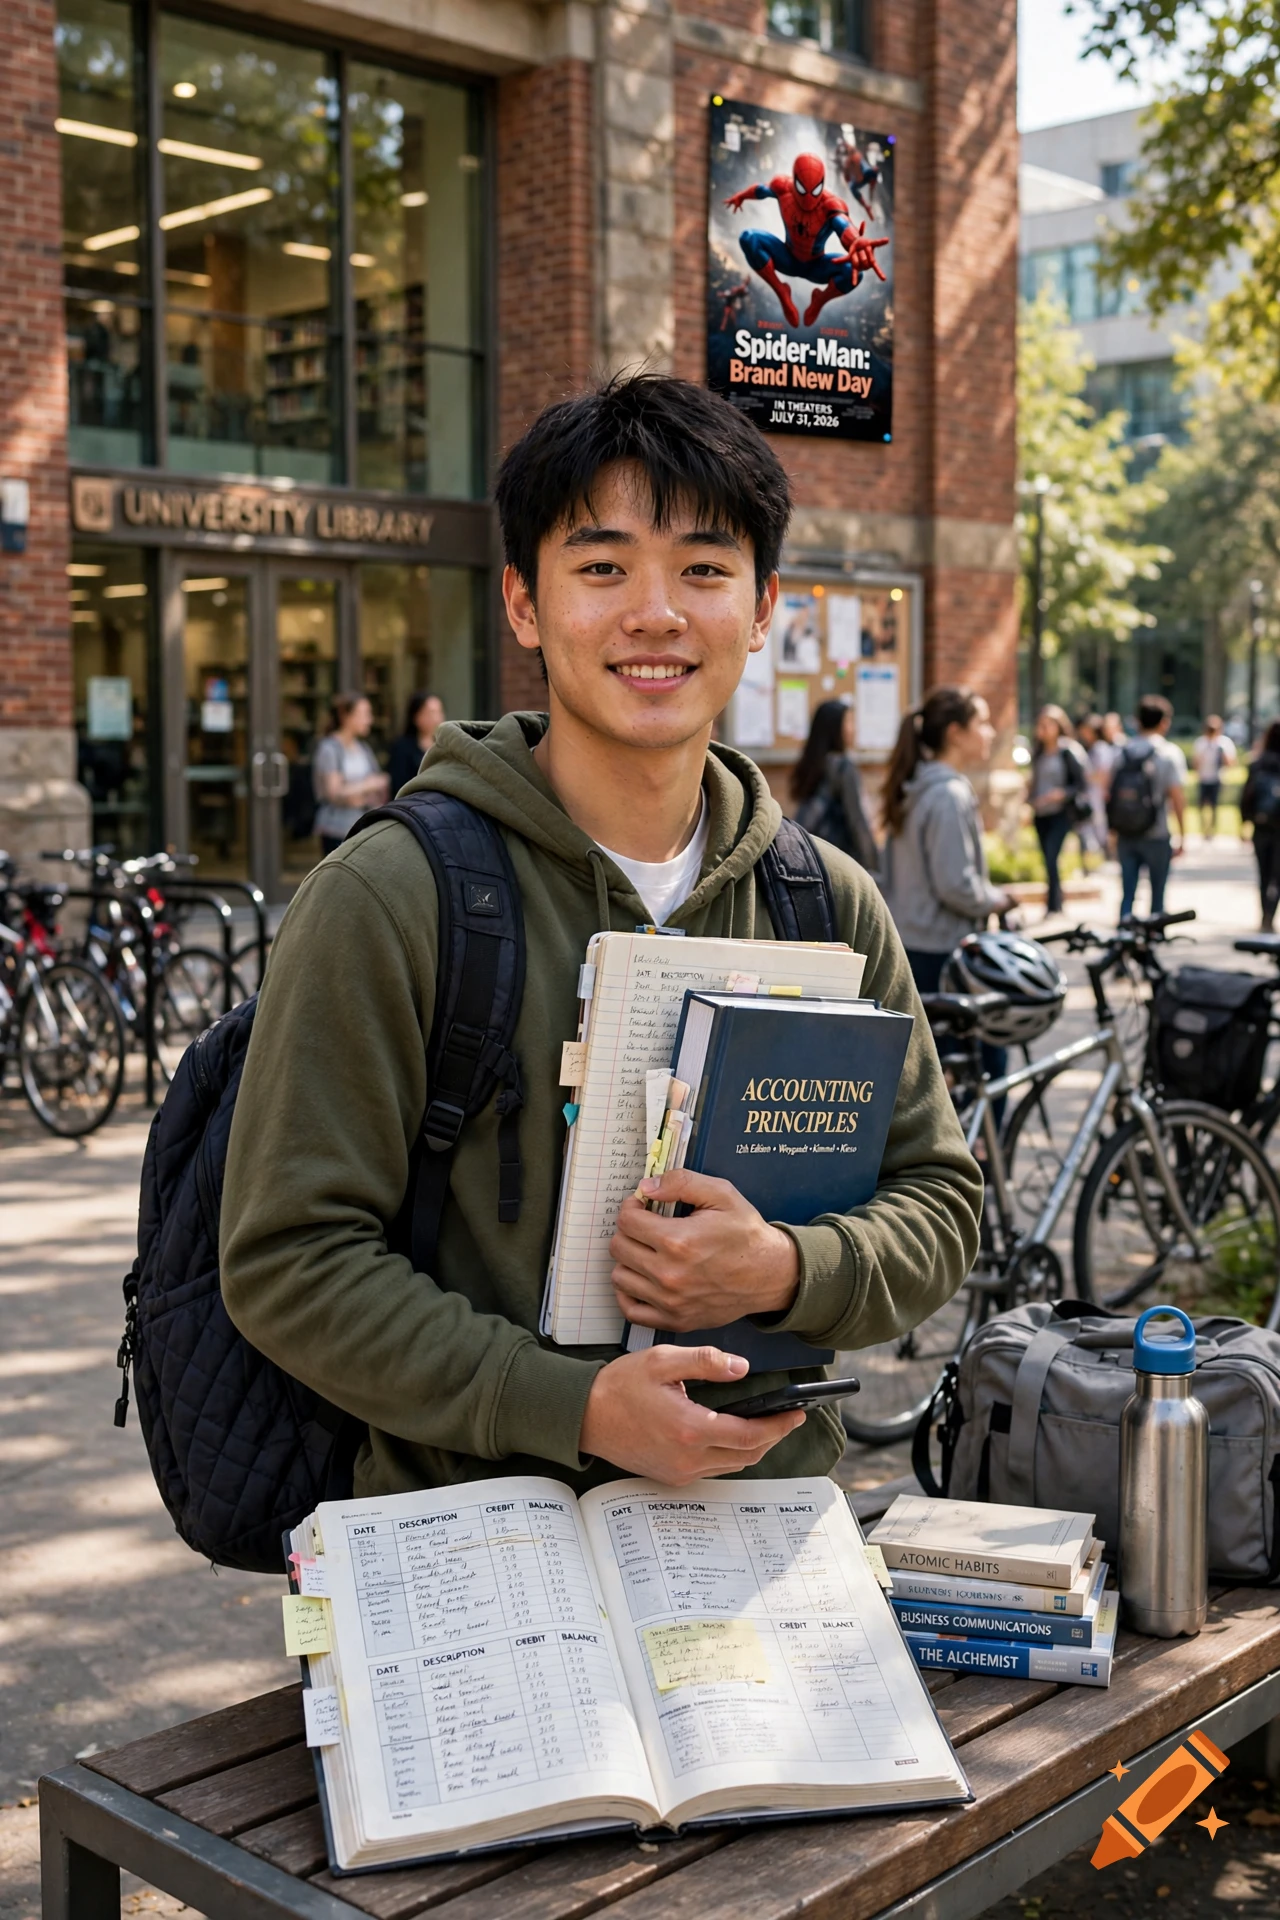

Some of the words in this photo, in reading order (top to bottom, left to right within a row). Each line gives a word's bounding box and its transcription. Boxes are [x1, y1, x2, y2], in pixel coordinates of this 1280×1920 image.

[734, 329, 871, 370] Spider-Man:
[729, 358, 788, 387] Brand
[792, 365, 834, 391] New
[837, 369, 873, 399] Day
[769, 411, 795, 424] JULY
[796, 413, 812, 428] 31,
[813, 415, 840, 428] 2026
[774, 400, 785, 411] IN
[787, 401, 833, 415] THEATERS
[123, 487, 311, 537] UNIVERSITY
[316, 502, 434, 545] LIBRARY
[741, 1077, 875, 1103] ACCOUNTING
[743, 1110, 859, 1133] PRINCIPLES
[353, 1526, 377, 1535] DATE
[398, 1512, 458, 1530] DESCRIPTION
[485, 1503, 515, 1513] CREDIT
[528, 1502, 565, 1512] BALANCE
[612, 1506, 632, 1517] DATE
[648, 1503, 706, 1513] DESCRIPTION
[740, 1506, 766, 1514] CREDIT
[779, 1505, 814, 1513] BALANCE
[899, 1553, 950, 1569] ATOMIC
[955, 1559, 1000, 1575] HABITS
[779, 1622, 807, 1630] CREDIT
[900, 1611, 950, 1626] BUSINESS
[952, 1616, 1052, 1636] COMMUNICATIONS
[376, 1665, 400, 1676] DATE
[423, 1647, 485, 1667] DESCRIPTION
[561, 1633, 598, 1644] BALANCE
[918, 1647, 943, 1662] THE
[946, 1650, 1019, 1669] ALCHEMIST
